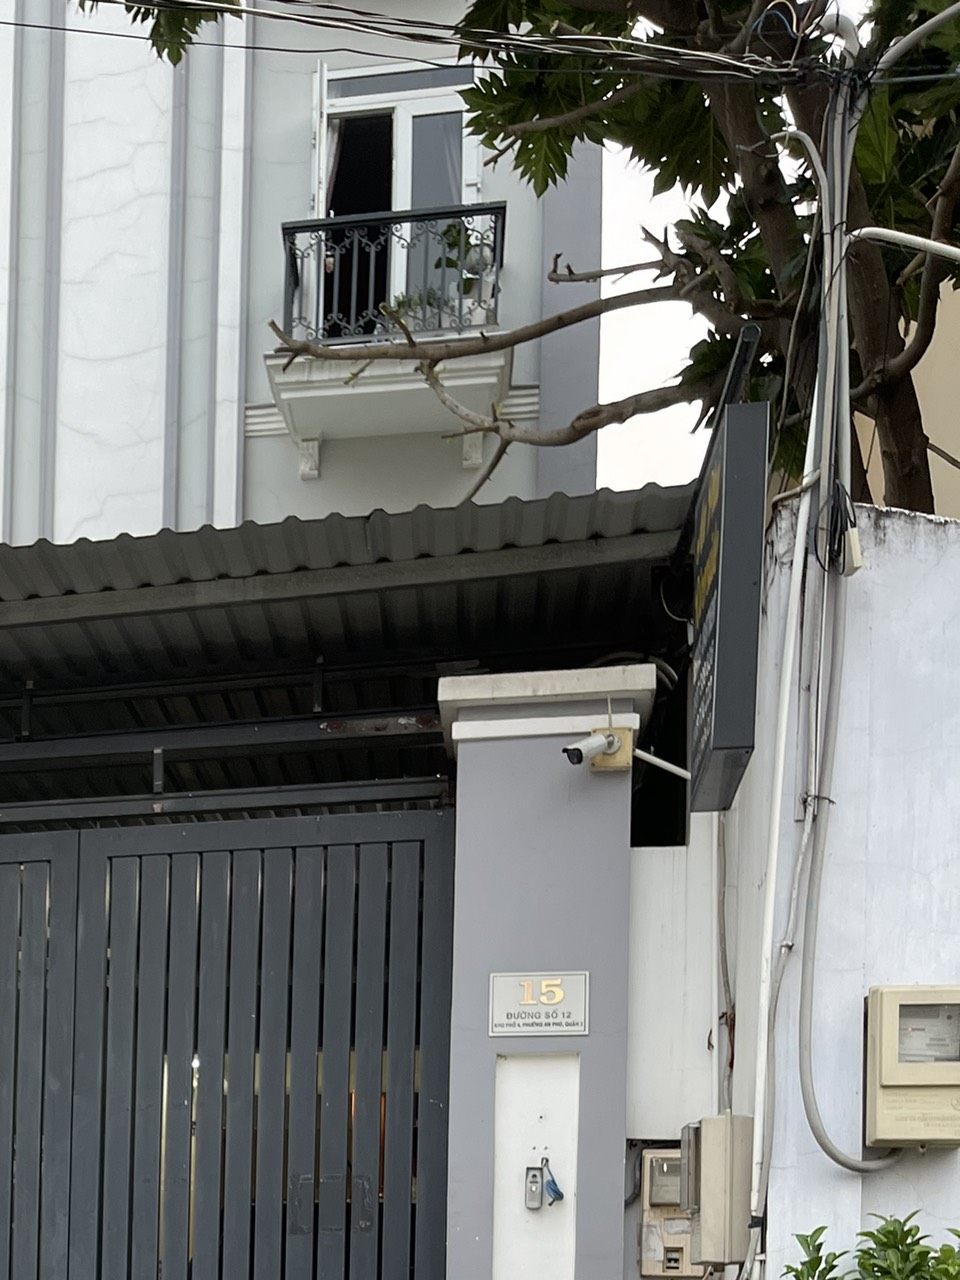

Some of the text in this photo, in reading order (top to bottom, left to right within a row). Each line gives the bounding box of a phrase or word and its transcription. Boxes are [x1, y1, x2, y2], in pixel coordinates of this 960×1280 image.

[519, 978, 565, 1006] 15
[506, 1009, 572, 1020] ĐƯỜNG SỐ 12
